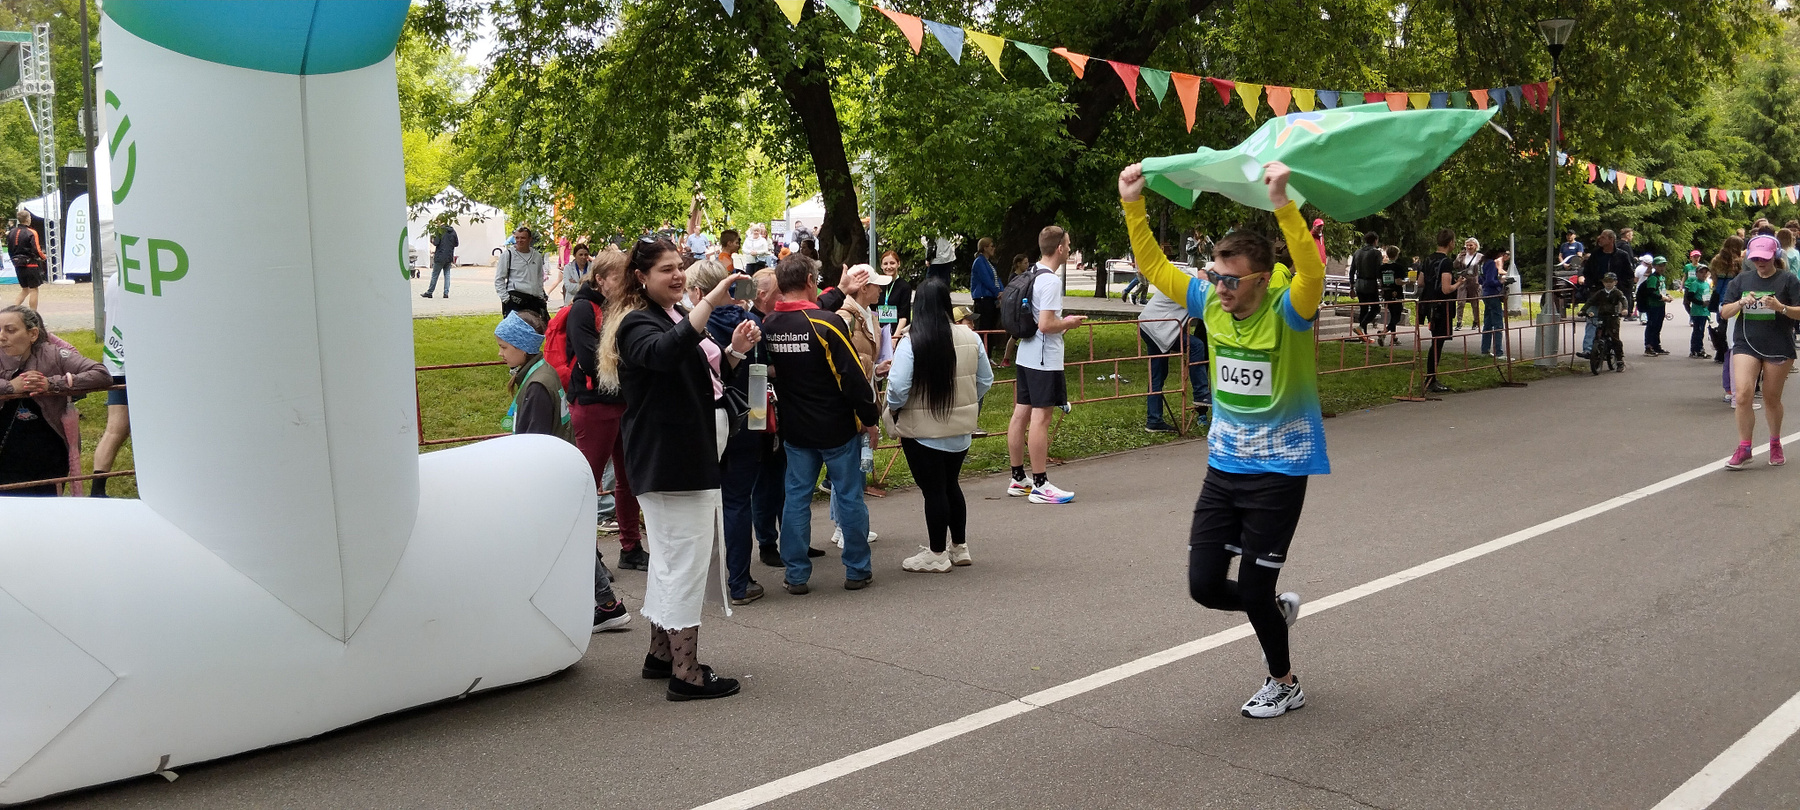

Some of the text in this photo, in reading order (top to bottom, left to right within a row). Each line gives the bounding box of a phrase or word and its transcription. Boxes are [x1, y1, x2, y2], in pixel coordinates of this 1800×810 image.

[75, 209, 86, 241] СБЕР
[114, 232, 189, 297] ЕР
[765, 332, 809, 342] eutschland
[1221, 365, 1264, 387] 0459
